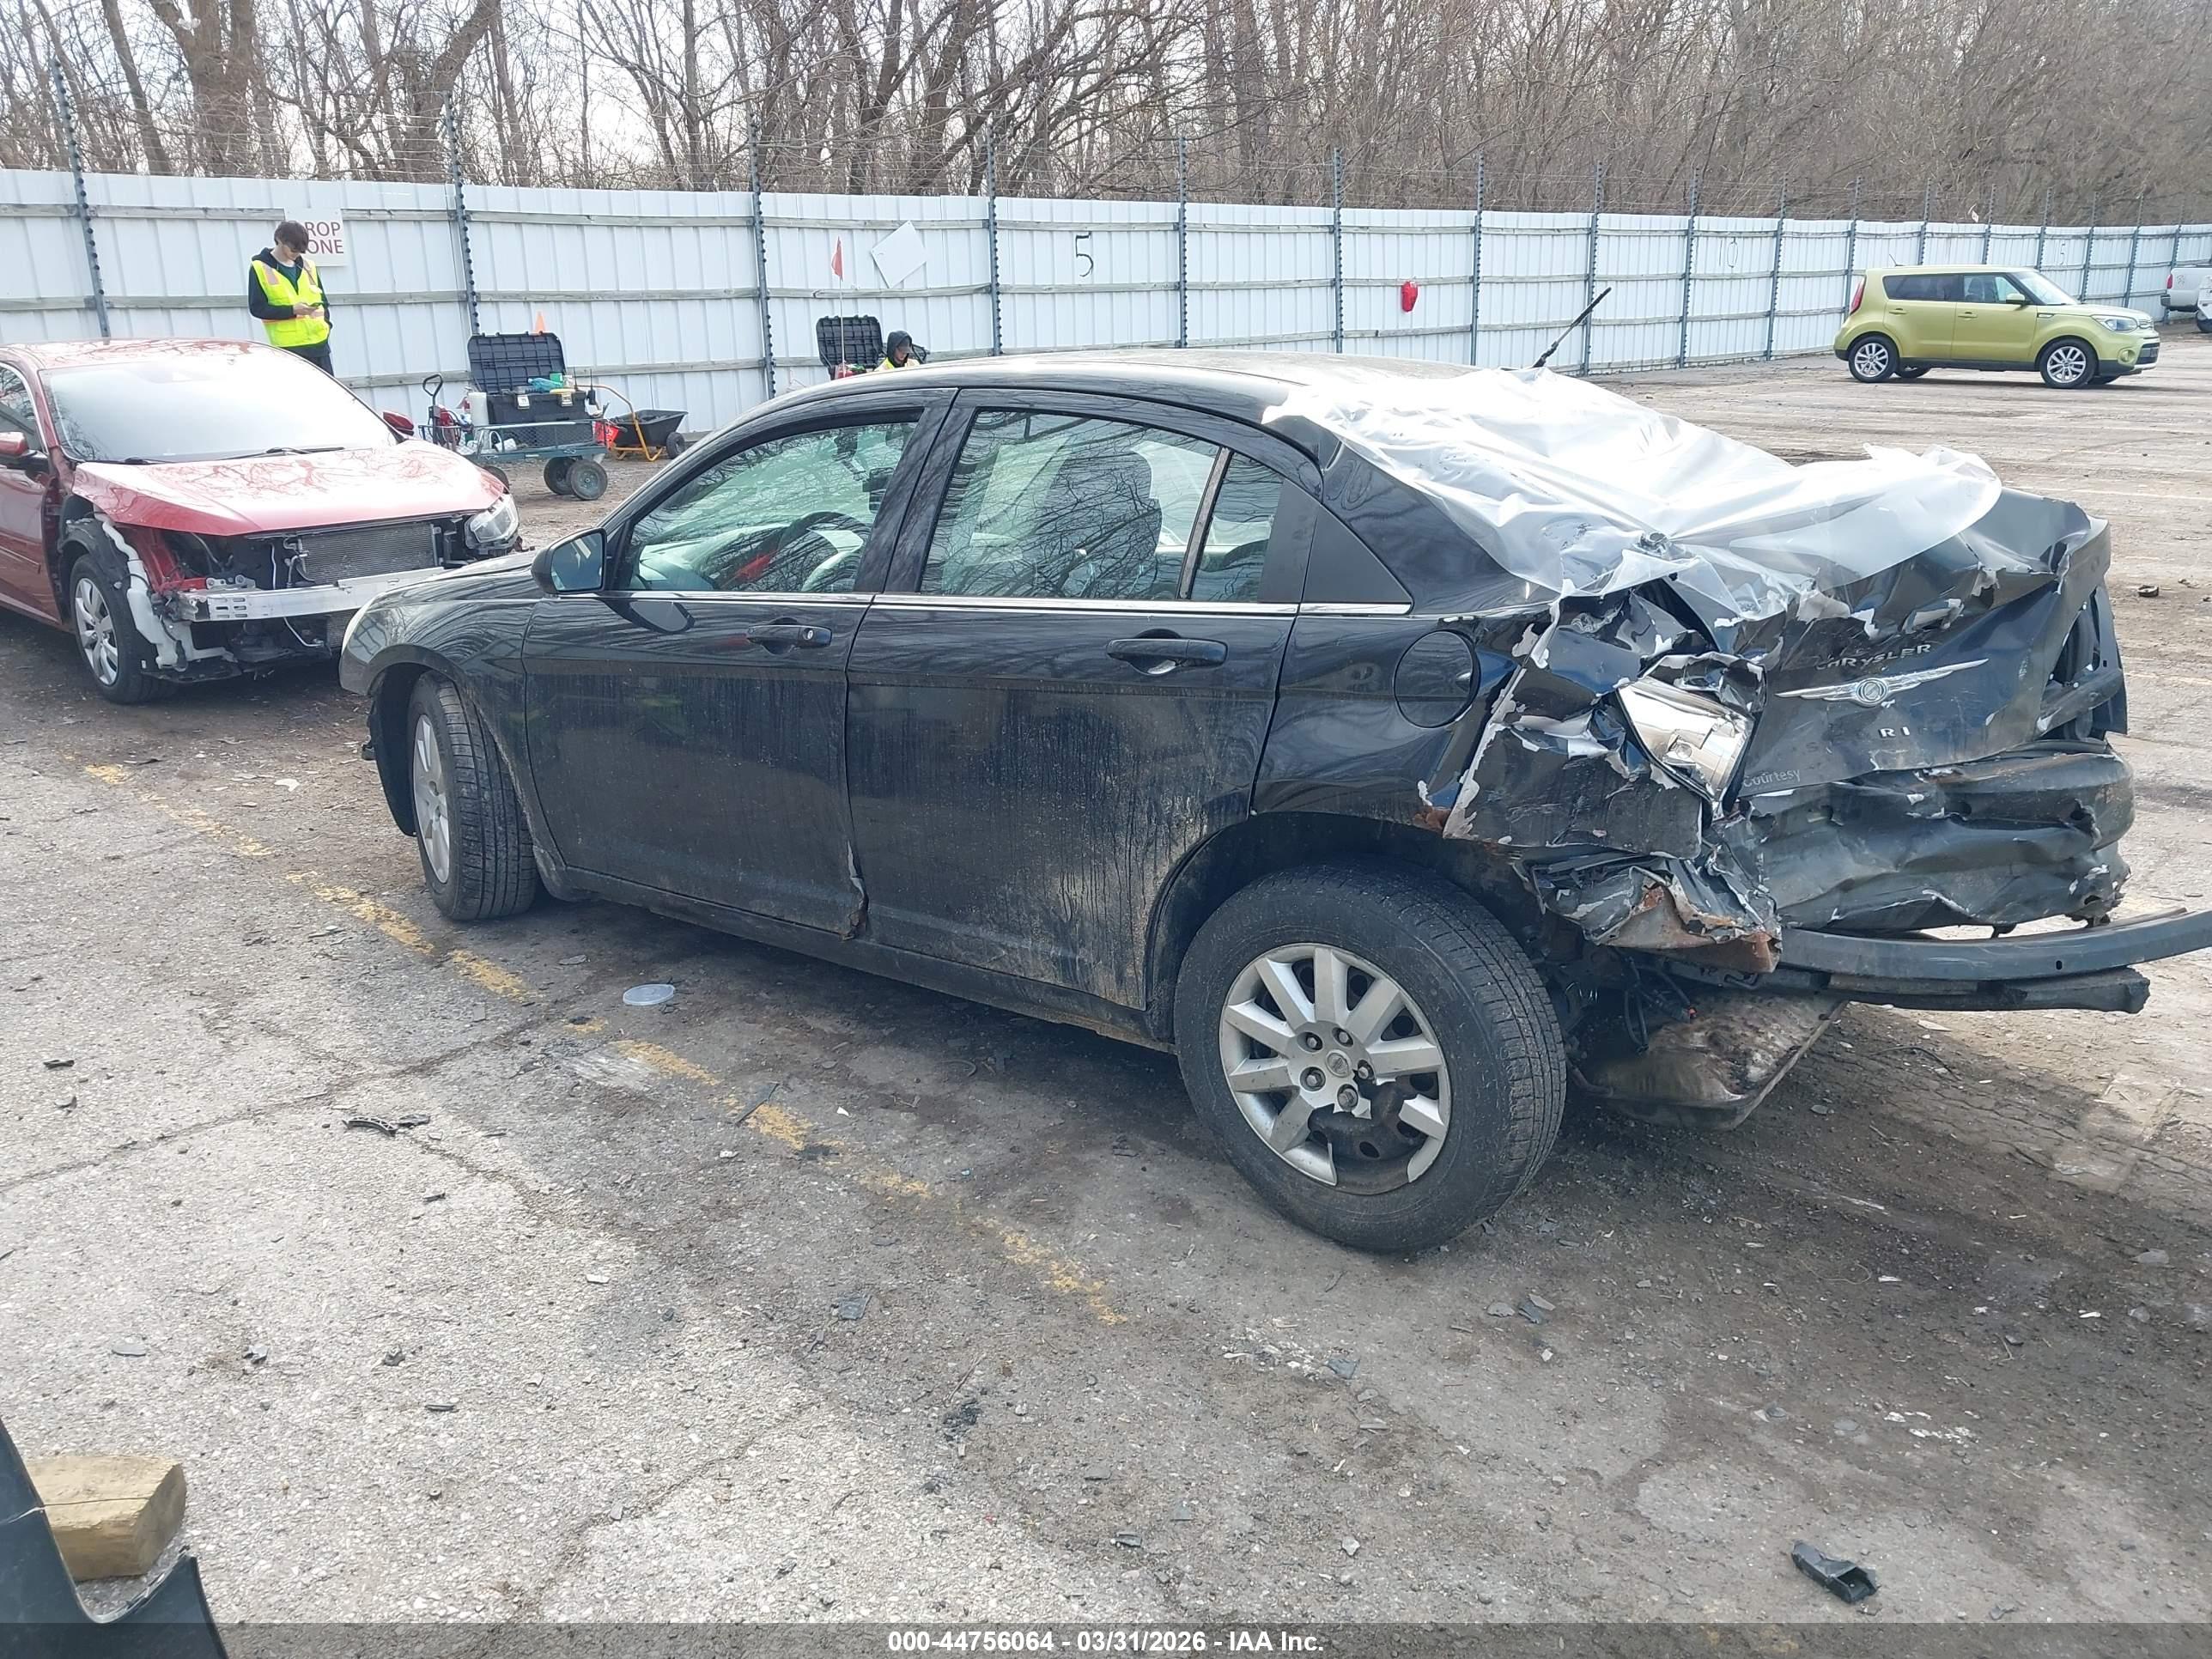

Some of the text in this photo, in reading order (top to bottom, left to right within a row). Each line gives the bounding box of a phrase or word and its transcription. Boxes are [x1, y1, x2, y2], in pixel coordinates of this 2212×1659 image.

[303, 221, 341, 237] ROP
[305, 239, 344, 254] ONE
[1074, 231, 1094, 277] 5
[1742, 769, 1801, 787] Courtesy
